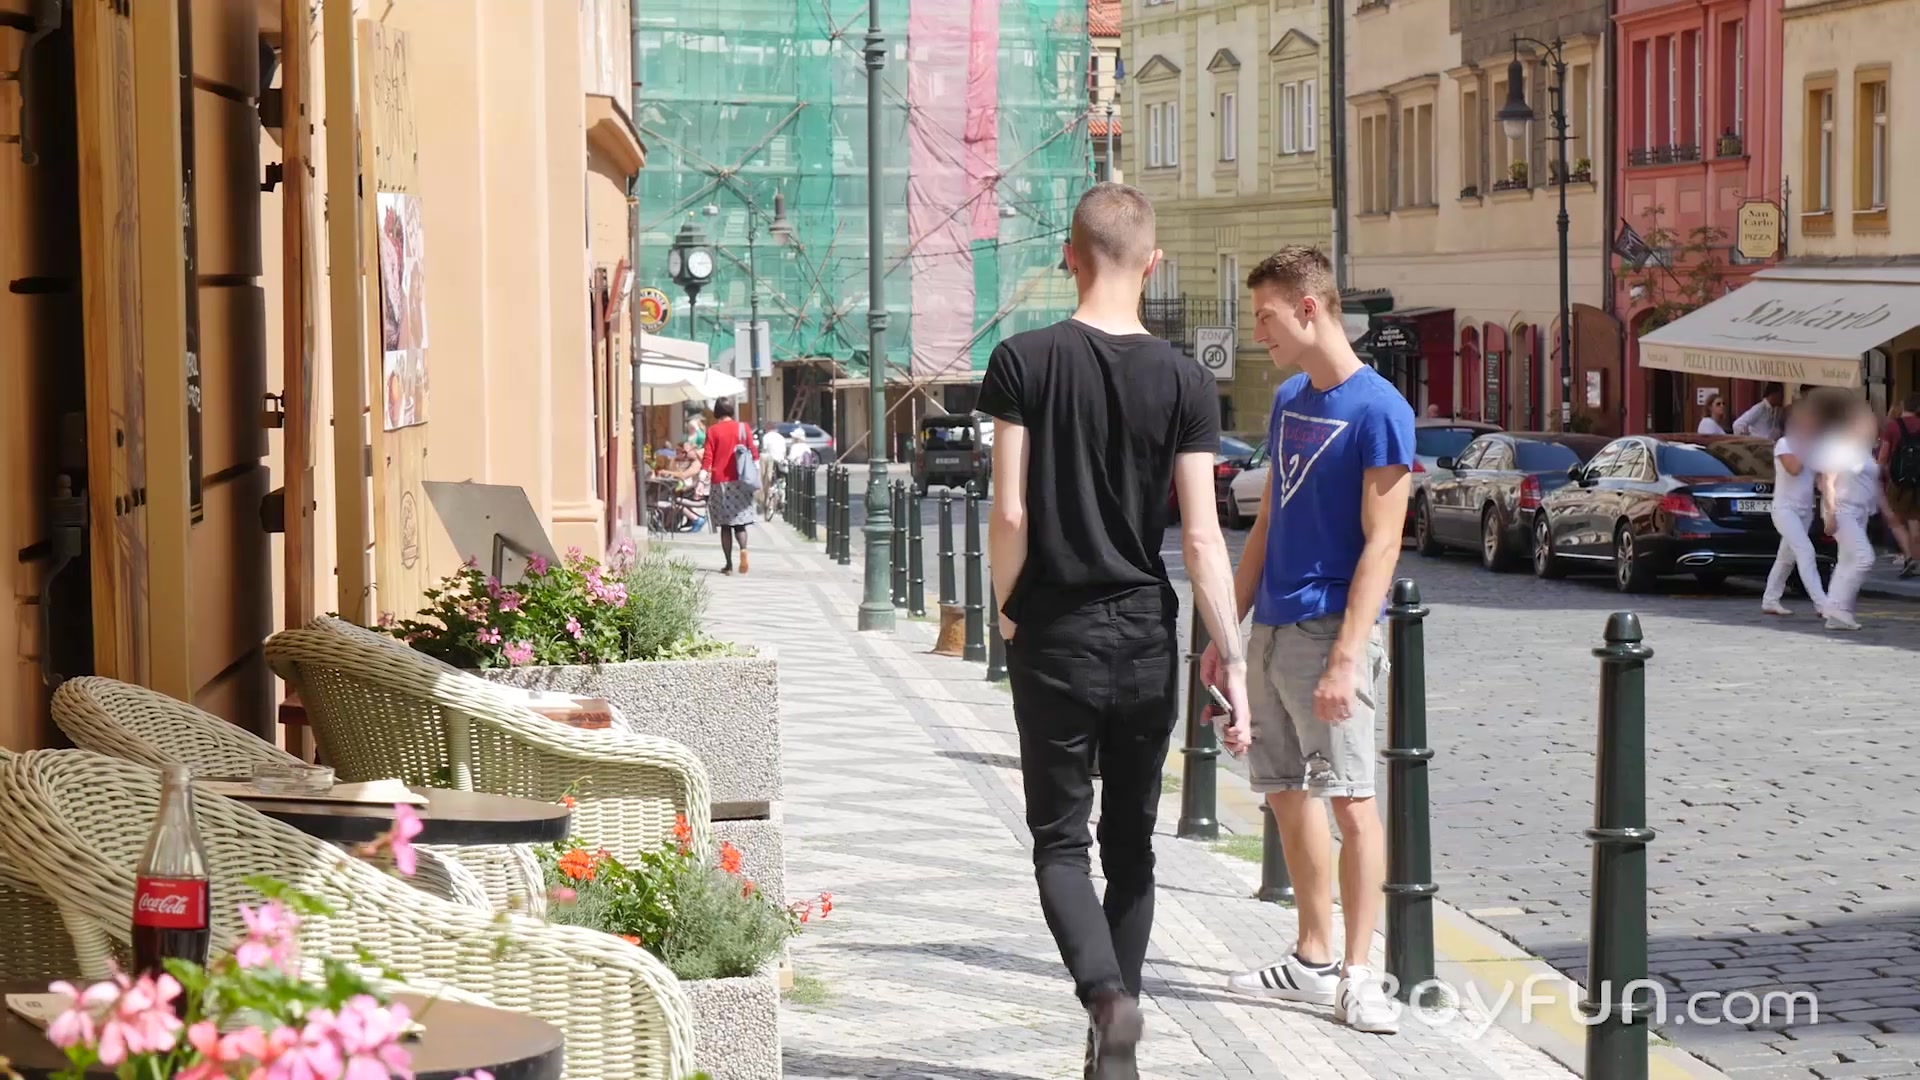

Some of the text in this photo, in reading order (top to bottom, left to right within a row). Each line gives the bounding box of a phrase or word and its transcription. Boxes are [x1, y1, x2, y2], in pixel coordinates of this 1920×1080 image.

[1749, 210, 1769, 218] San
[1744, 219, 1774, 227] Carlo
[1744, 233, 1772, 241] PIZZA
[1378, 333, 1405, 342] cognac
[1207, 350, 1222, 363] 30
[1683, 352, 1706, 370] PIZZA
[1714, 356, 1745, 374] CUCINA
[1747, 358, 1806, 379] NAPOLETANA
[1739, 501, 1755, 510] 3SR
